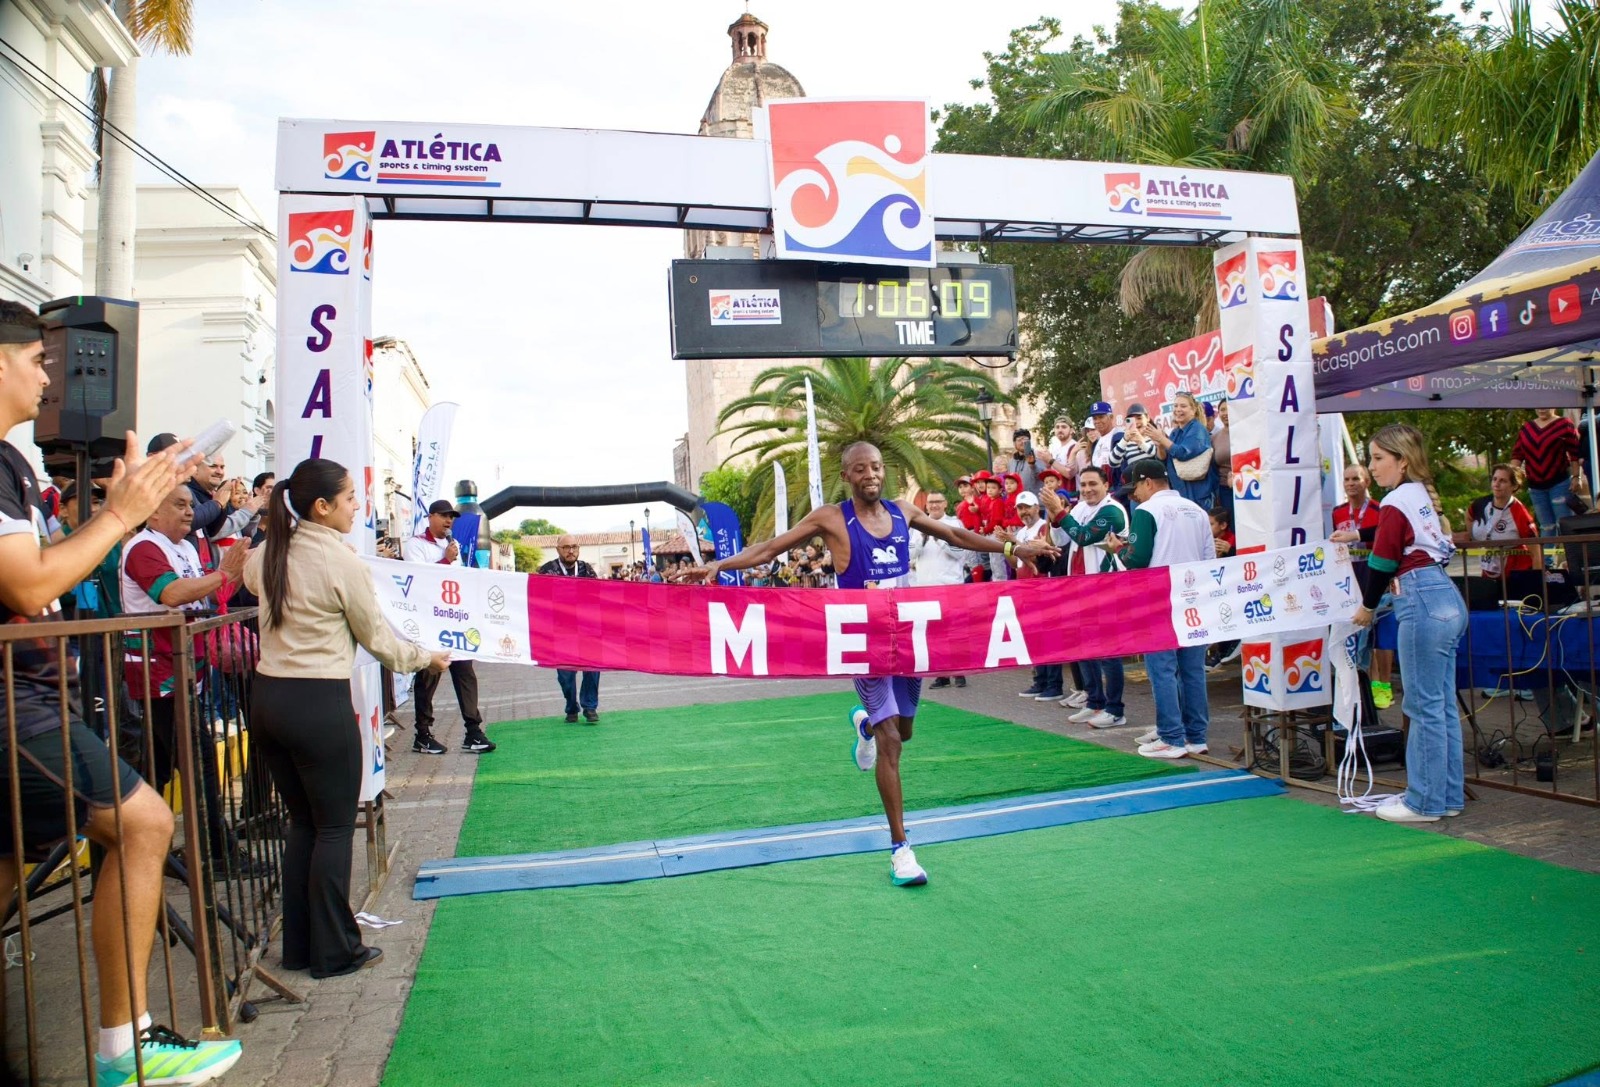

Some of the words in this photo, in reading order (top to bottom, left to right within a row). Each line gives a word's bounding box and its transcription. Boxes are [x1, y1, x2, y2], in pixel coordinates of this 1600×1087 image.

[379, 162, 410, 170] sports
[421, 162, 452, 173] timing
[454, 164, 488, 172] system
[1176, 200, 1197, 208] timing
[857, 280, 989, 317] 1:06:09
[895, 320, 935, 345] TIME
[1093, 403, 1099, 411] B
[869, 568, 884, 576] THE
[391, 601, 418, 613] VIZSLA
[708, 595, 1033, 676] META
